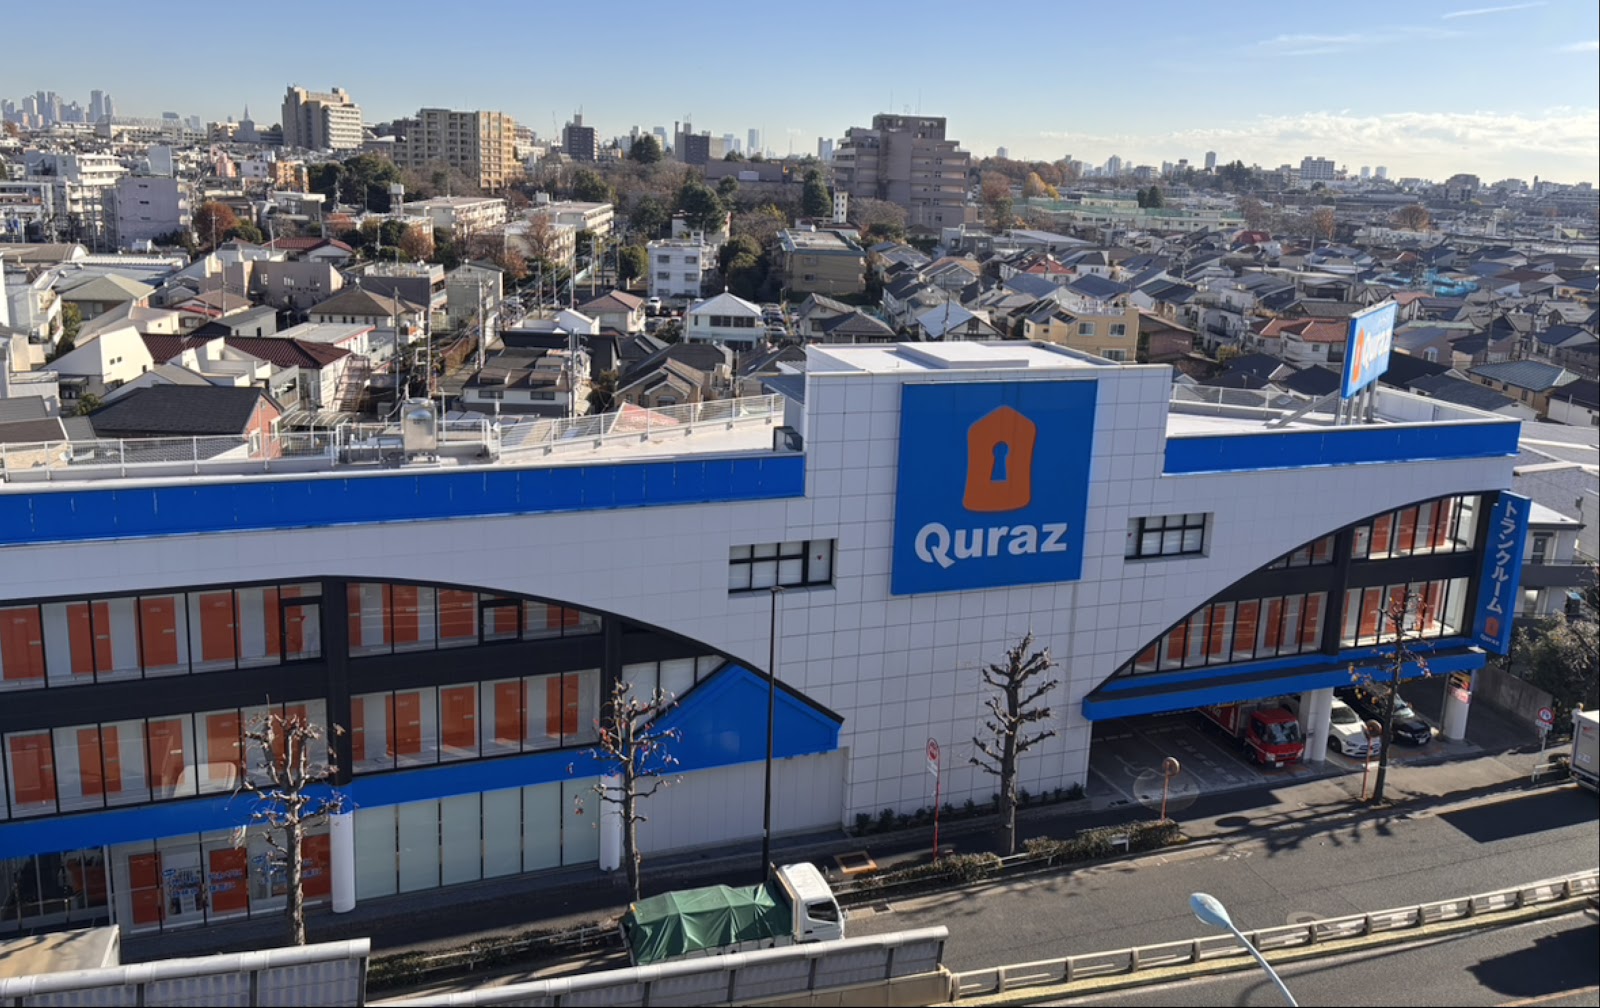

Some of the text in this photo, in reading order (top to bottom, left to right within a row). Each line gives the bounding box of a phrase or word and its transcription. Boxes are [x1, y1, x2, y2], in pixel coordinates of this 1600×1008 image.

[914, 521, 1068, 569] Quraz
[1486, 500, 1518, 614] トランクルーム
